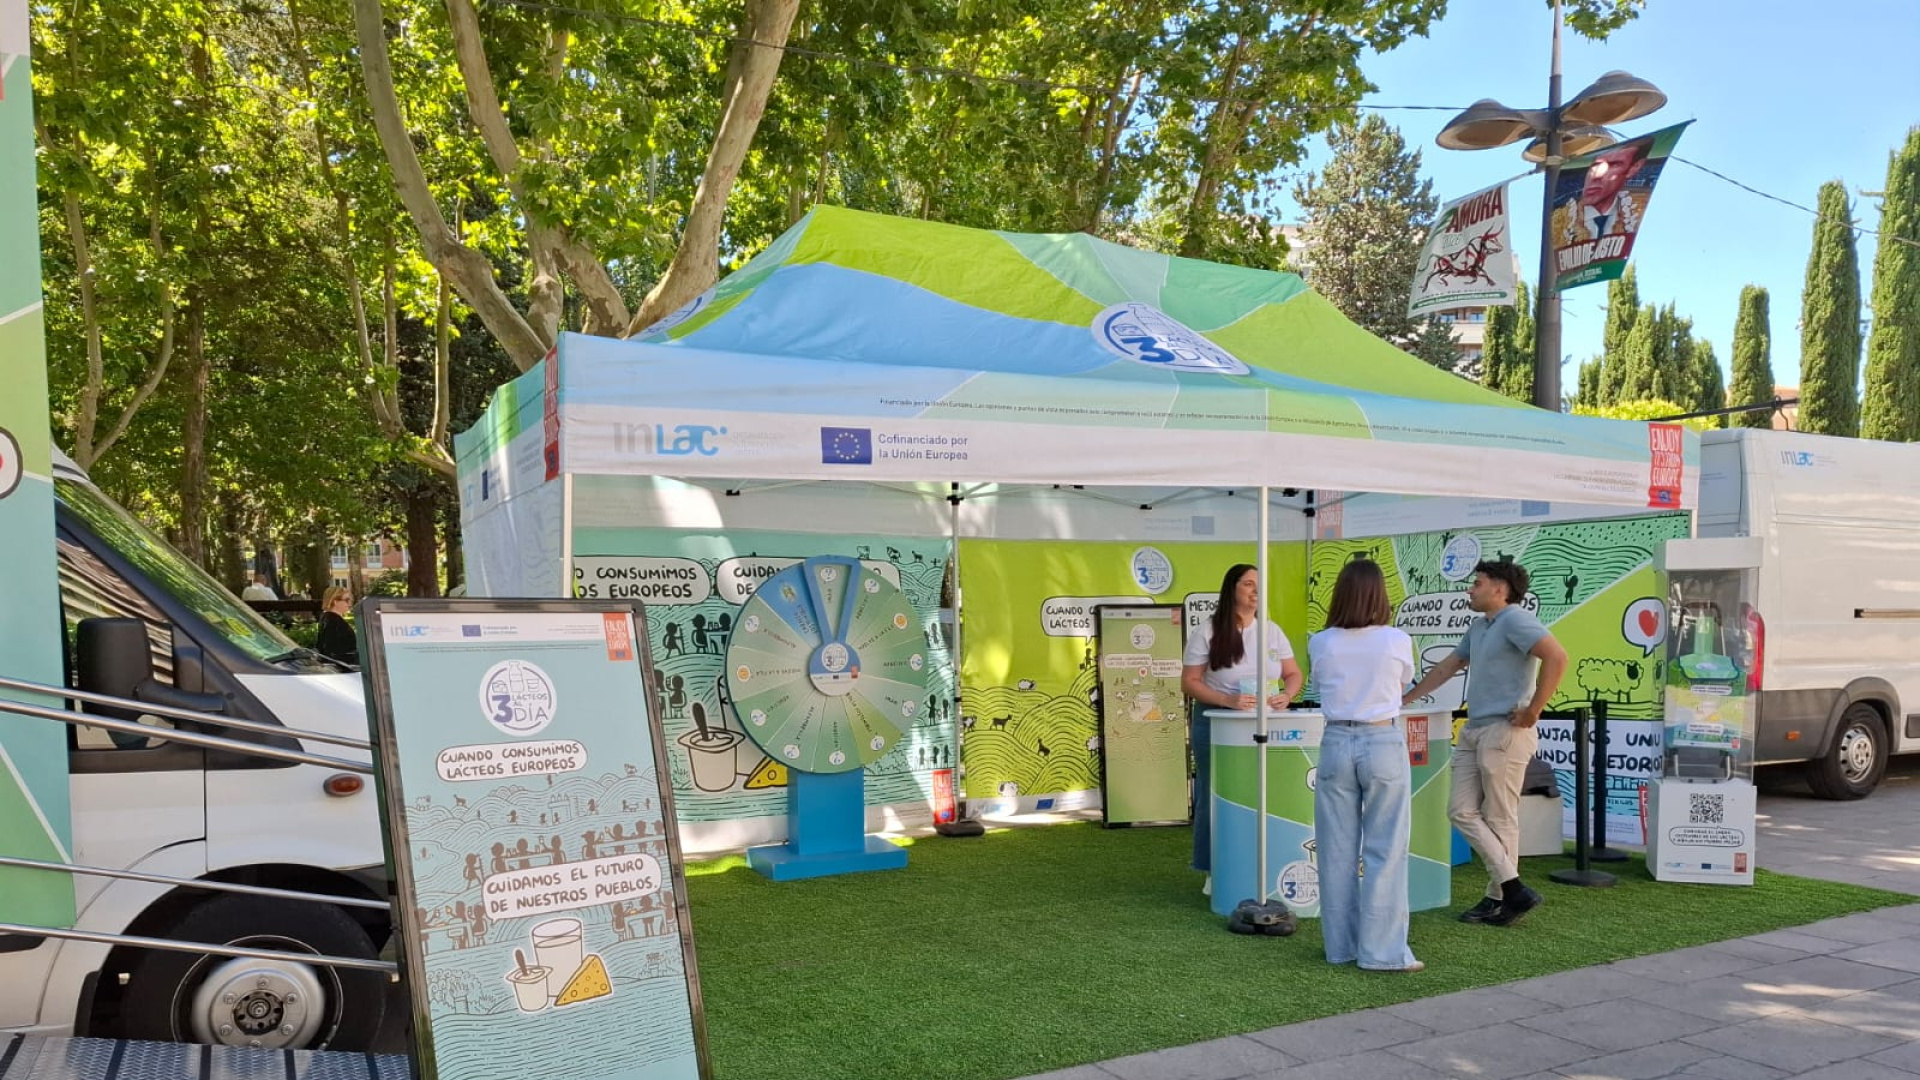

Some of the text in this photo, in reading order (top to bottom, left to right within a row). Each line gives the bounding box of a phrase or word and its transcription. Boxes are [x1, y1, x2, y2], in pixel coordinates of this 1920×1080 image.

[1120, 336, 1176, 363] 3
[878, 433, 968, 449] Cofinanciado por
[1651, 428, 1681, 451] ENJOY
[879, 448, 968, 461] la Unión Europea
[596, 564, 698, 580] CONSUMIMOS
[1442, 555, 1456, 572] 3
[1137, 566, 1150, 585] 3
[609, 583, 692, 598] EUROPEOS
[736, 583, 754, 596] DE
[1046, 605, 1083, 616] CUANDO
[1401, 598, 1443, 613] CUANDO
[1049, 616, 1091, 629] LÁCTEOS
[1397, 614, 1441, 628] LÁCTEOS
[512, 692, 548, 702] LÁCTEOS
[491, 694, 513, 723] 3
[514, 703, 549, 722] DÍA
[440, 743, 580, 764] CUANDO CONSUMIMOS
[446, 756, 577, 779] LÁCTEOS EUROPEOS
[487, 858, 644, 895] CUIDAMOS EL FUTURO
[490, 875, 658, 913] DE NUESTROS PUEBLOS.
[1284, 881, 1297, 900] 3
